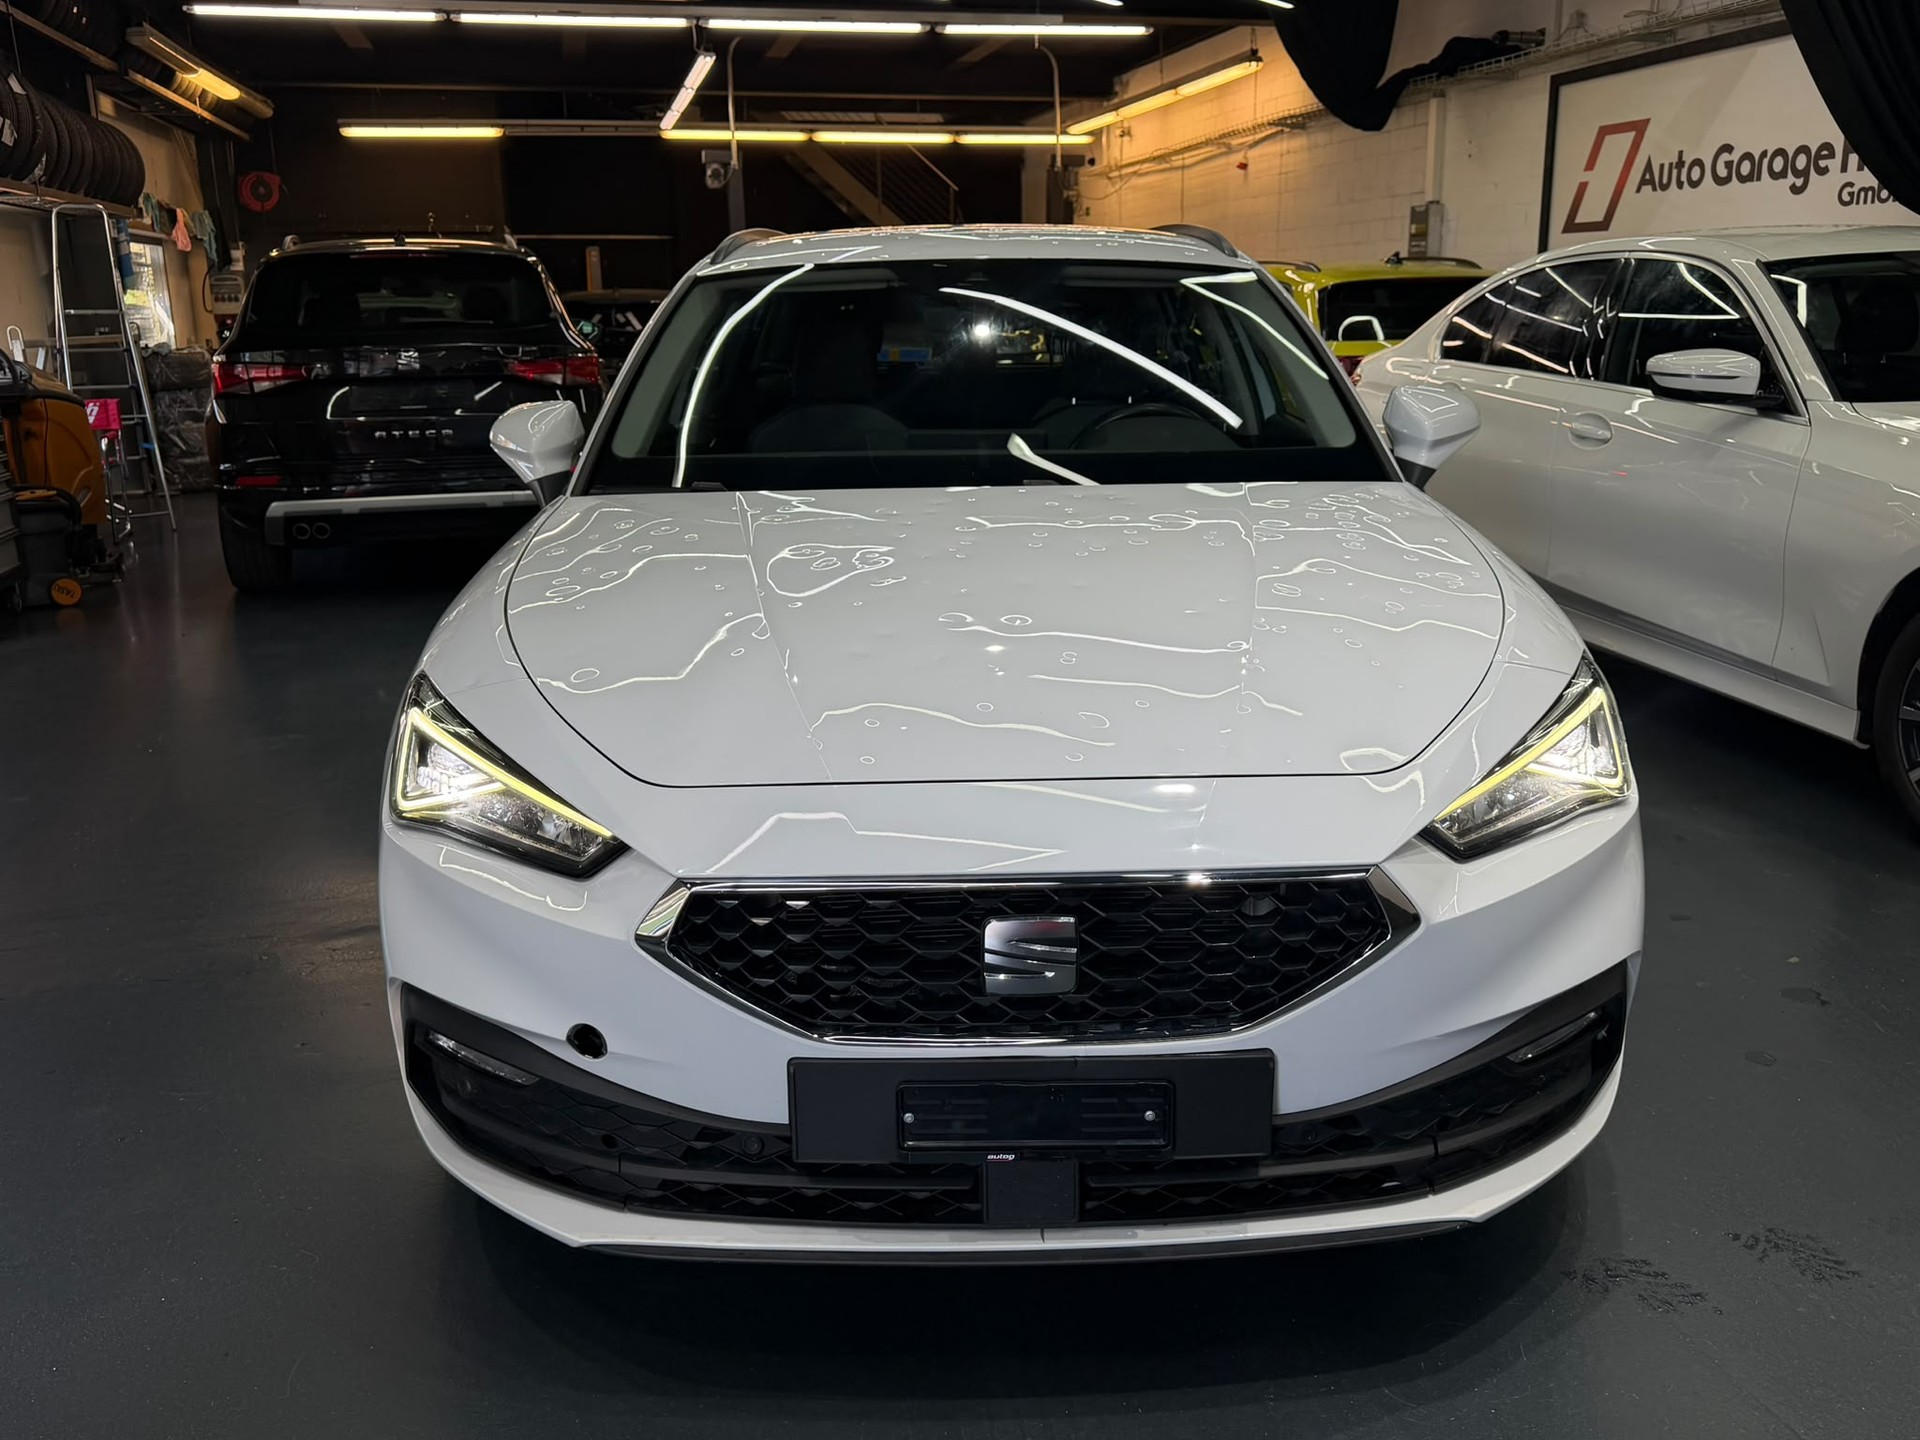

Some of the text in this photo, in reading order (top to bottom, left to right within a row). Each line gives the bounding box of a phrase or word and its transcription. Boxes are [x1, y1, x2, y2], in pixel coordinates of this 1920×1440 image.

[1635, 150, 1706, 194] Auto
[1710, 141, 1836, 196] Garage
[1837, 181, 1897, 207] Gmb
